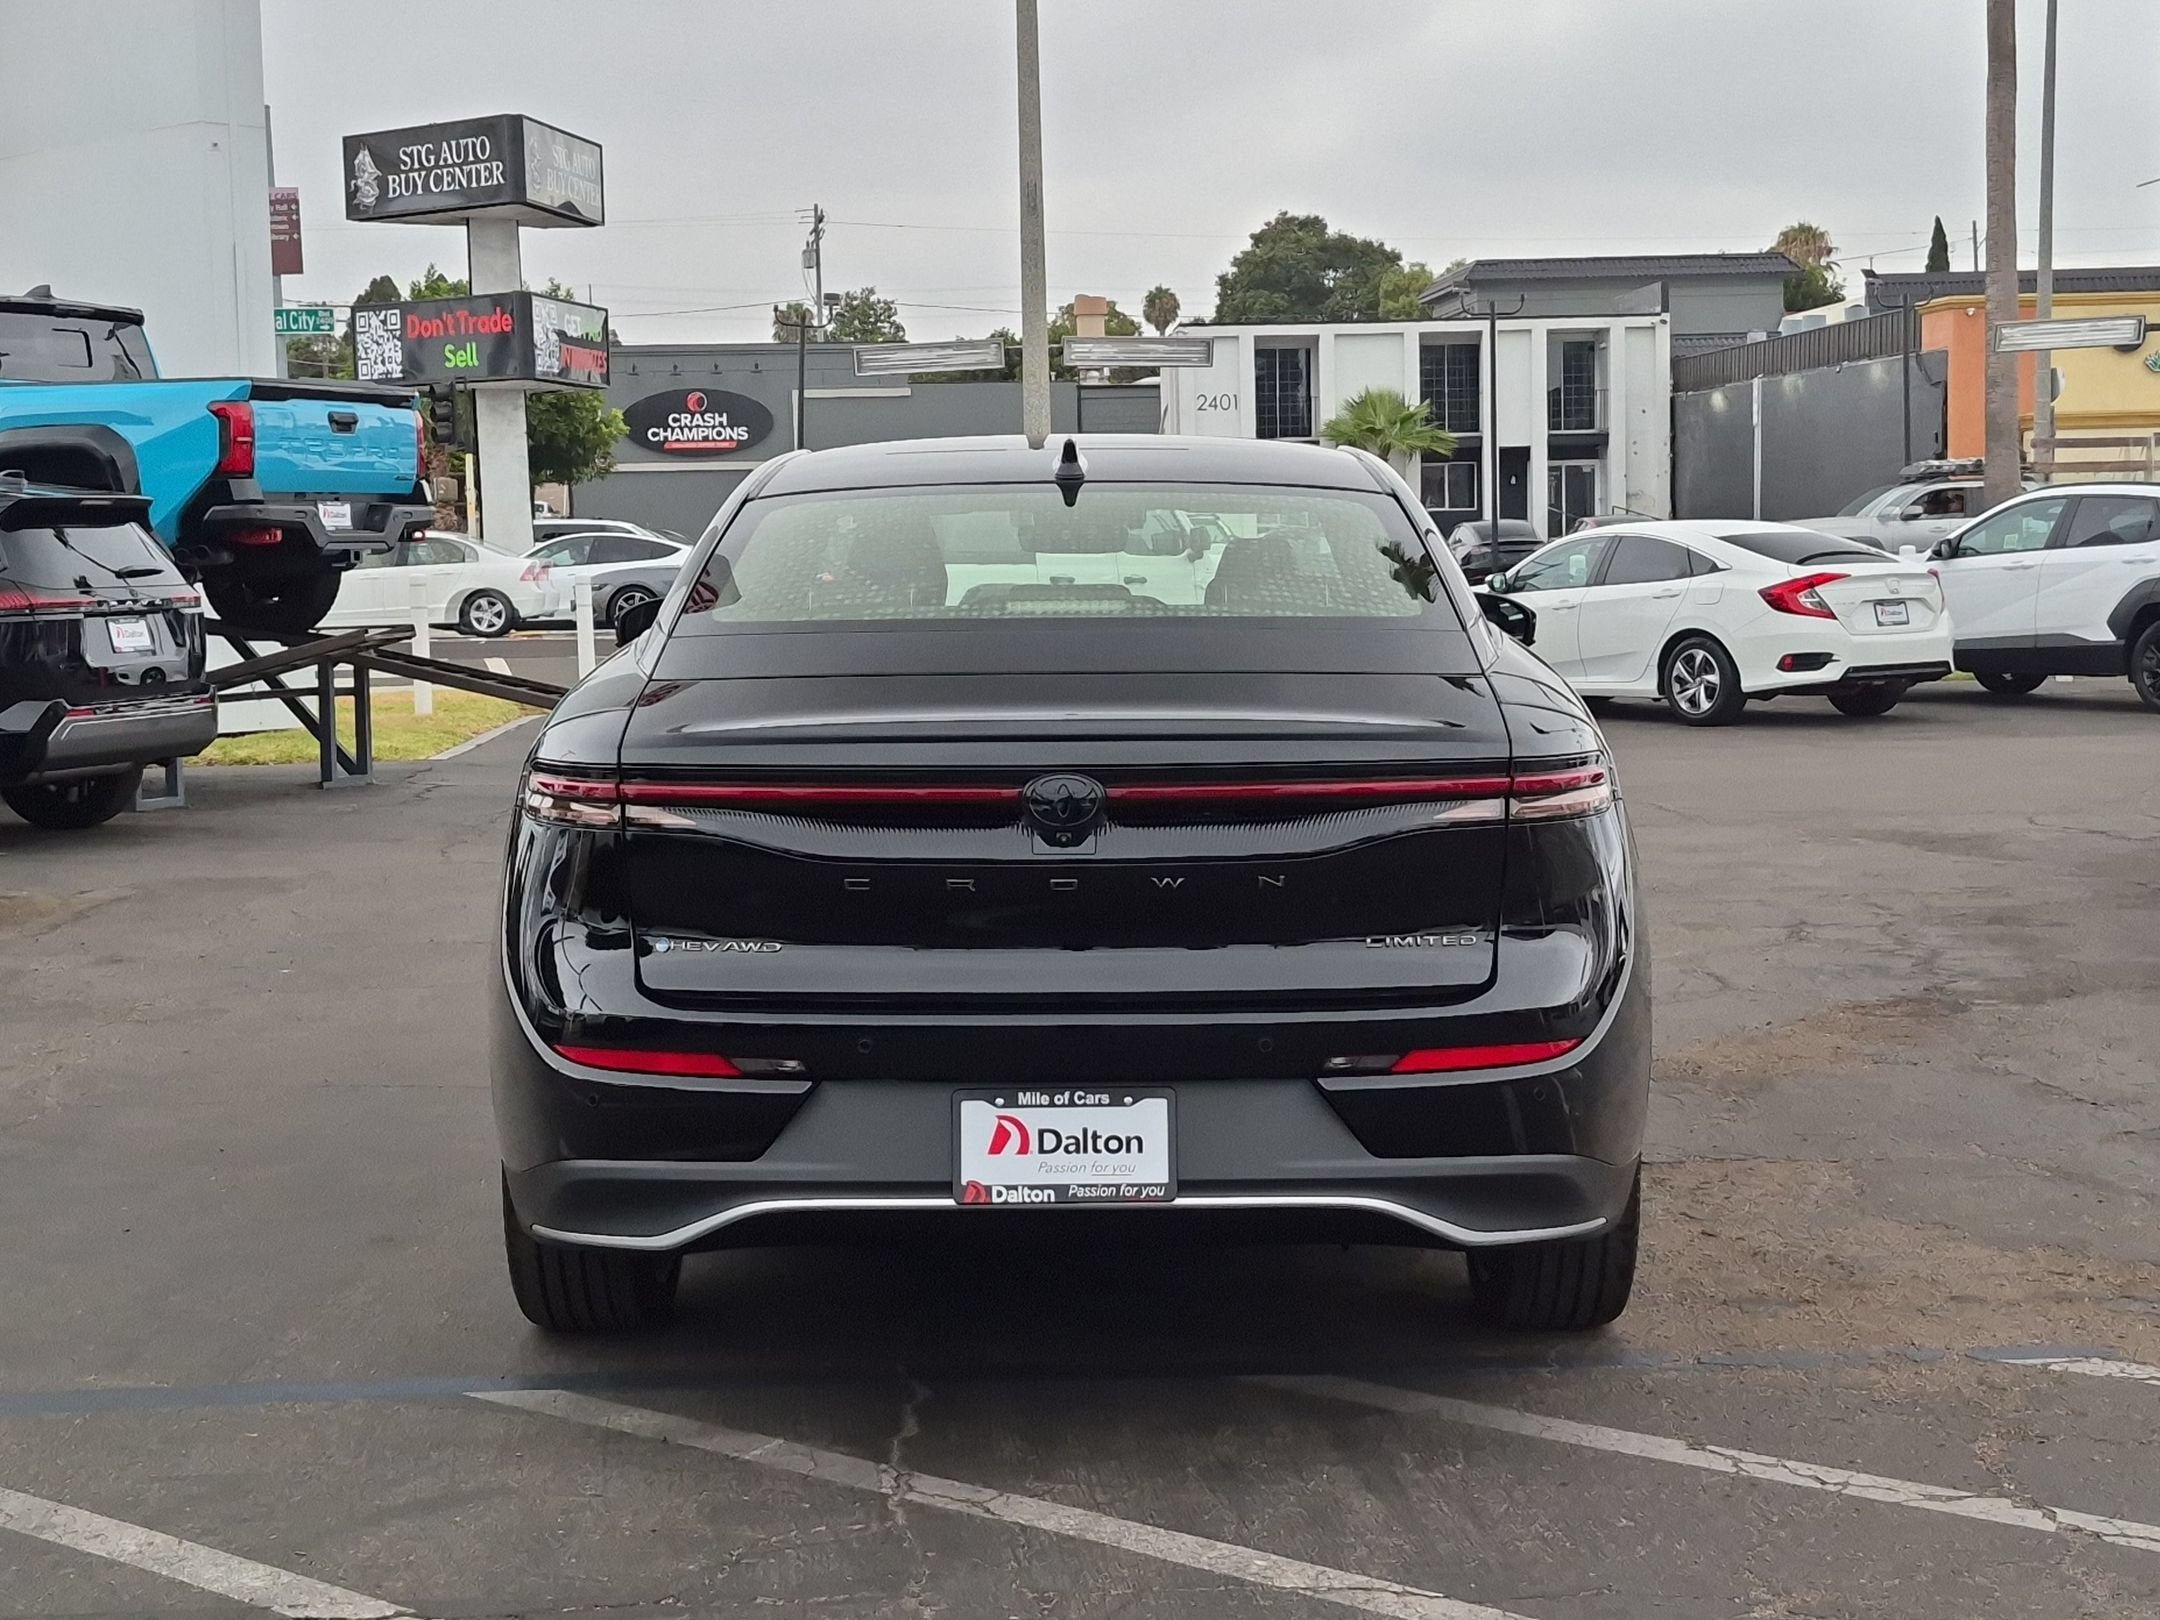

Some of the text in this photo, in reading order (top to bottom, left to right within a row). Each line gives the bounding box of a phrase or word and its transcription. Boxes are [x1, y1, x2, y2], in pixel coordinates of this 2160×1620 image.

[400, 135, 490, 170] STG AUTO
[387, 161, 506, 198] BUY CENTER
[290, 311, 315, 331] City
[406, 306, 513, 339] Don't Trade
[444, 341, 479, 368] Sell
[1196, 393, 1238, 411] 2401
[668, 412, 728, 428] CRASH
[647, 426, 749, 442] CHAMPIONS
[844, 876, 1285, 891] CROWN
[1366, 935, 1478, 948] LIMITED
[1018, 1091, 1110, 1106] Mile of Cars
[1037, 1127, 1144, 1155] Dalton
[1037, 1160, 1136, 1176] Passion for you
[992, 1185, 1056, 1204] Dalton
[1067, 1184, 1166, 1199] Passion for you
